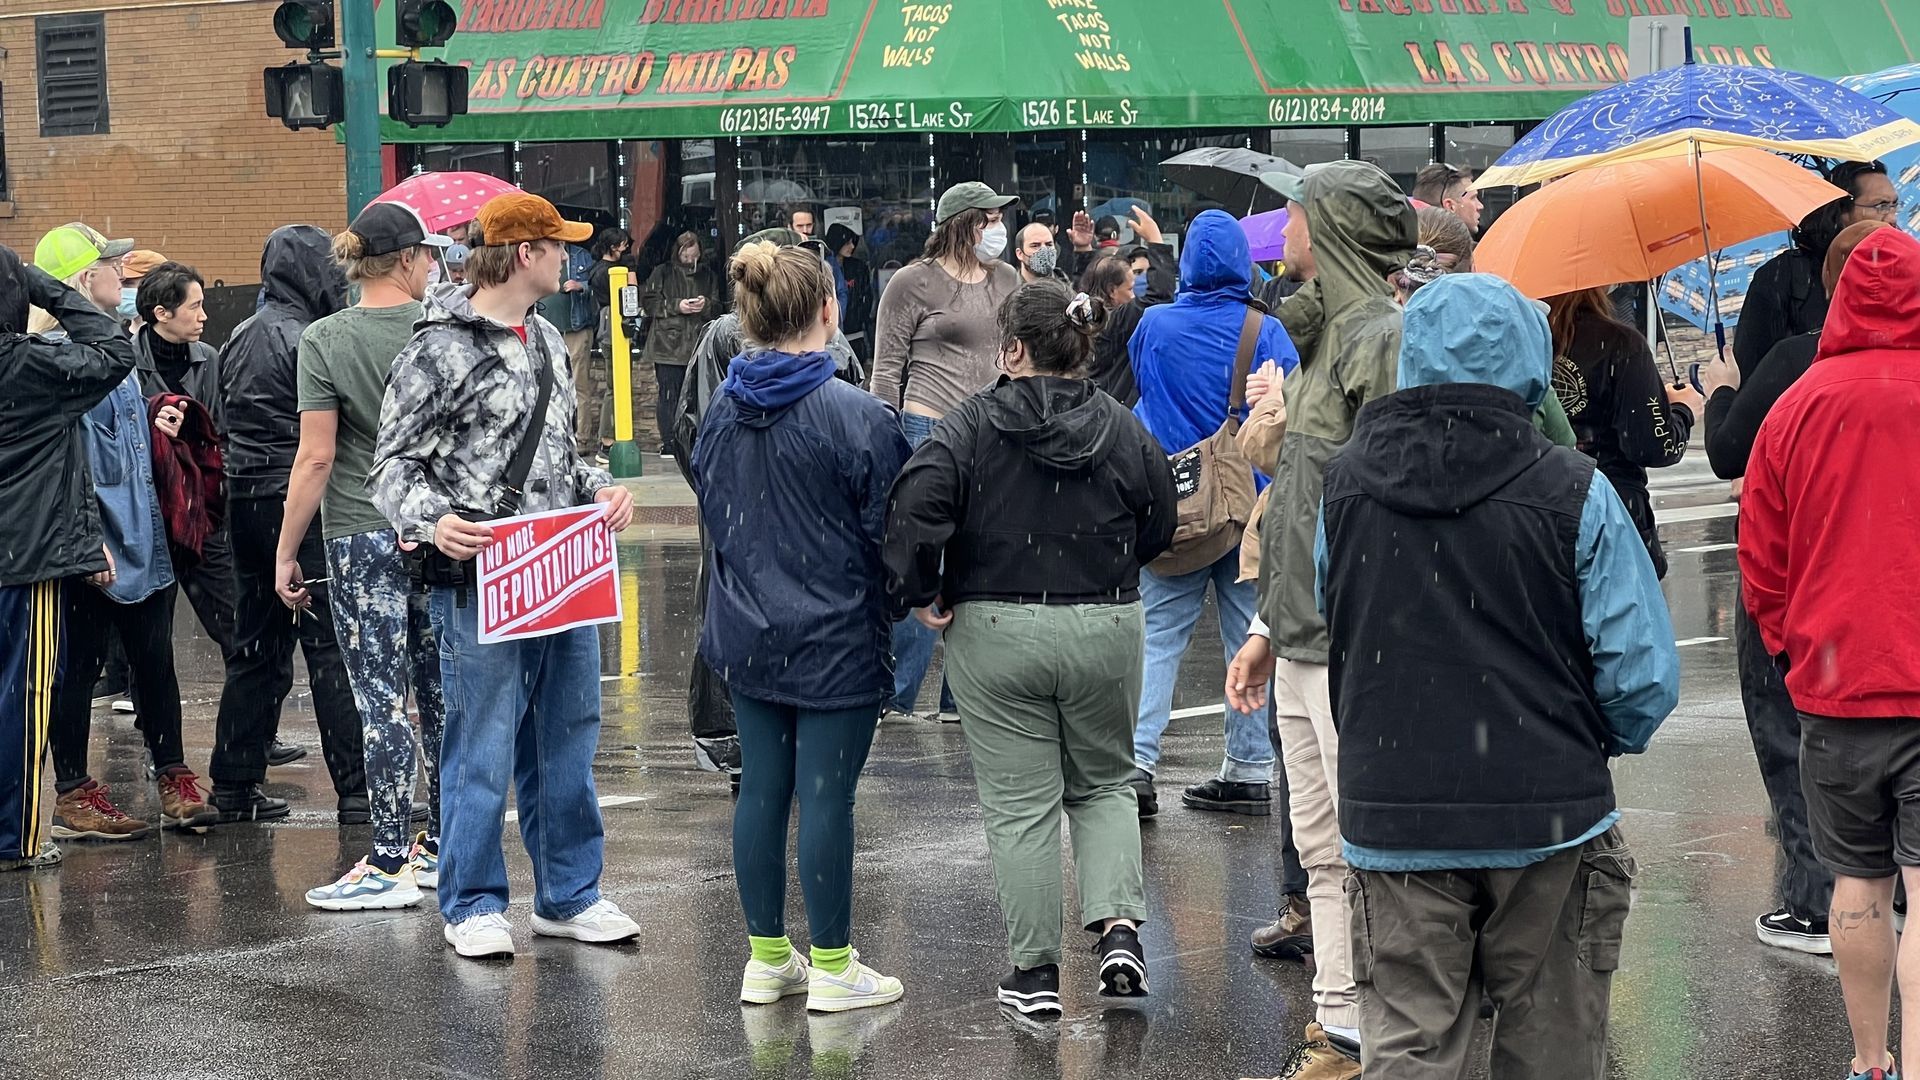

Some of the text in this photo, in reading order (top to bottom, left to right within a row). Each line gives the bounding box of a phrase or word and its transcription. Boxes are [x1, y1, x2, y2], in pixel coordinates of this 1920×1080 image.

[901, 3, 953, 27] TACOS
[1056, 11, 1109, 33] TACOS
[903, 25, 940, 43] NOT
[1078, 32, 1111, 50] NOT
[882, 44, 935, 68] WALLS
[1074, 49, 1131, 72] WALLS
[1403, 40, 1490, 84] LAS
[1491, 41, 1629, 84] CUATRO
[458, 44, 797, 99] AS CUATRO MILPAS
[719, 105, 830, 132] (612)315-3947
[849, 103, 890, 129] 1526
[895, 102, 907, 129] E
[1023, 100, 1059, 126] 1526
[1066, 99, 1077, 125] E
[1268, 97, 1386, 123] (612)834-8814
[1646, 396, 1670, 438] Punk
[485, 521, 536, 572] NO MORE
[487, 521, 611, 629] DEPORTATIONS!
